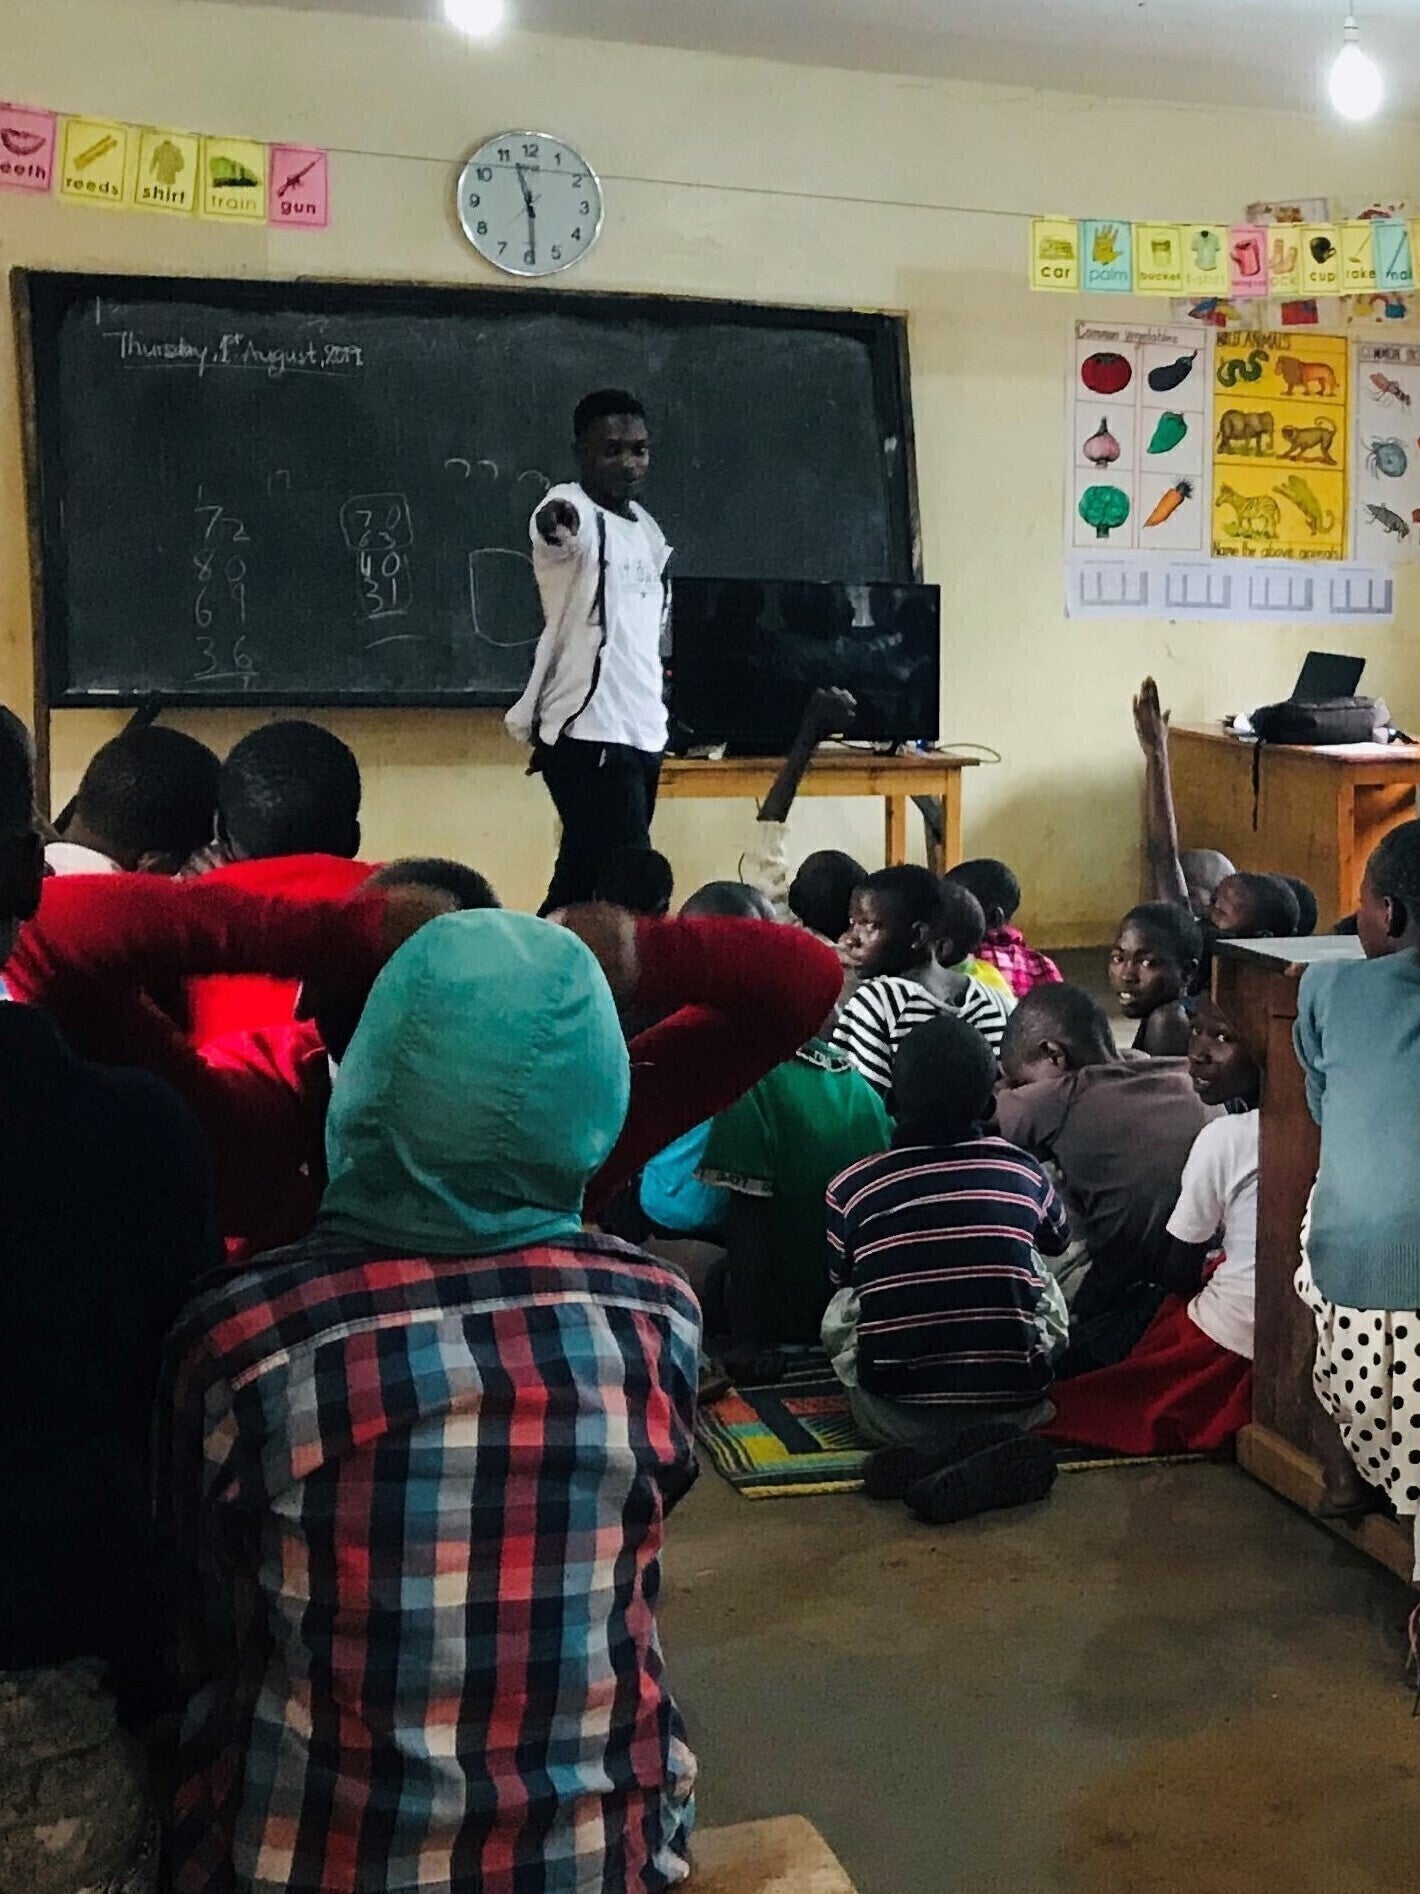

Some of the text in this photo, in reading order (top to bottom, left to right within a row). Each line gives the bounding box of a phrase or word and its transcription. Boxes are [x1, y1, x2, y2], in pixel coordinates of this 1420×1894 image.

[498, 149, 510, 162] 11
[522, 144, 539, 158] 12
[554, 153, 561, 166] 1
[0, 163, 46, 180] eeth
[477, 168, 493, 183] 10
[66, 178, 119, 196] reeds
[572, 174, 583, 188] 2
[142, 187, 185, 204] shirt
[469, 194, 480, 208] 9
[211, 195, 257, 211] train
[281, 200, 317, 215] gun
[579, 201, 589, 215] 3
[477, 221, 488, 235] 8
[571, 227, 581, 241] 4
[498, 241, 508, 255] 7
[552, 245, 561, 260] 5
[1041, 265, 1071, 279] car
[1089, 268, 1128, 283] palm
[1140, 272, 1181, 282] bucket
[1310, 272, 1336, 283] cup
[1346, 270, 1376, 280] rake
[194, 505, 251, 543] 72
[194, 635, 253, 675] 36
